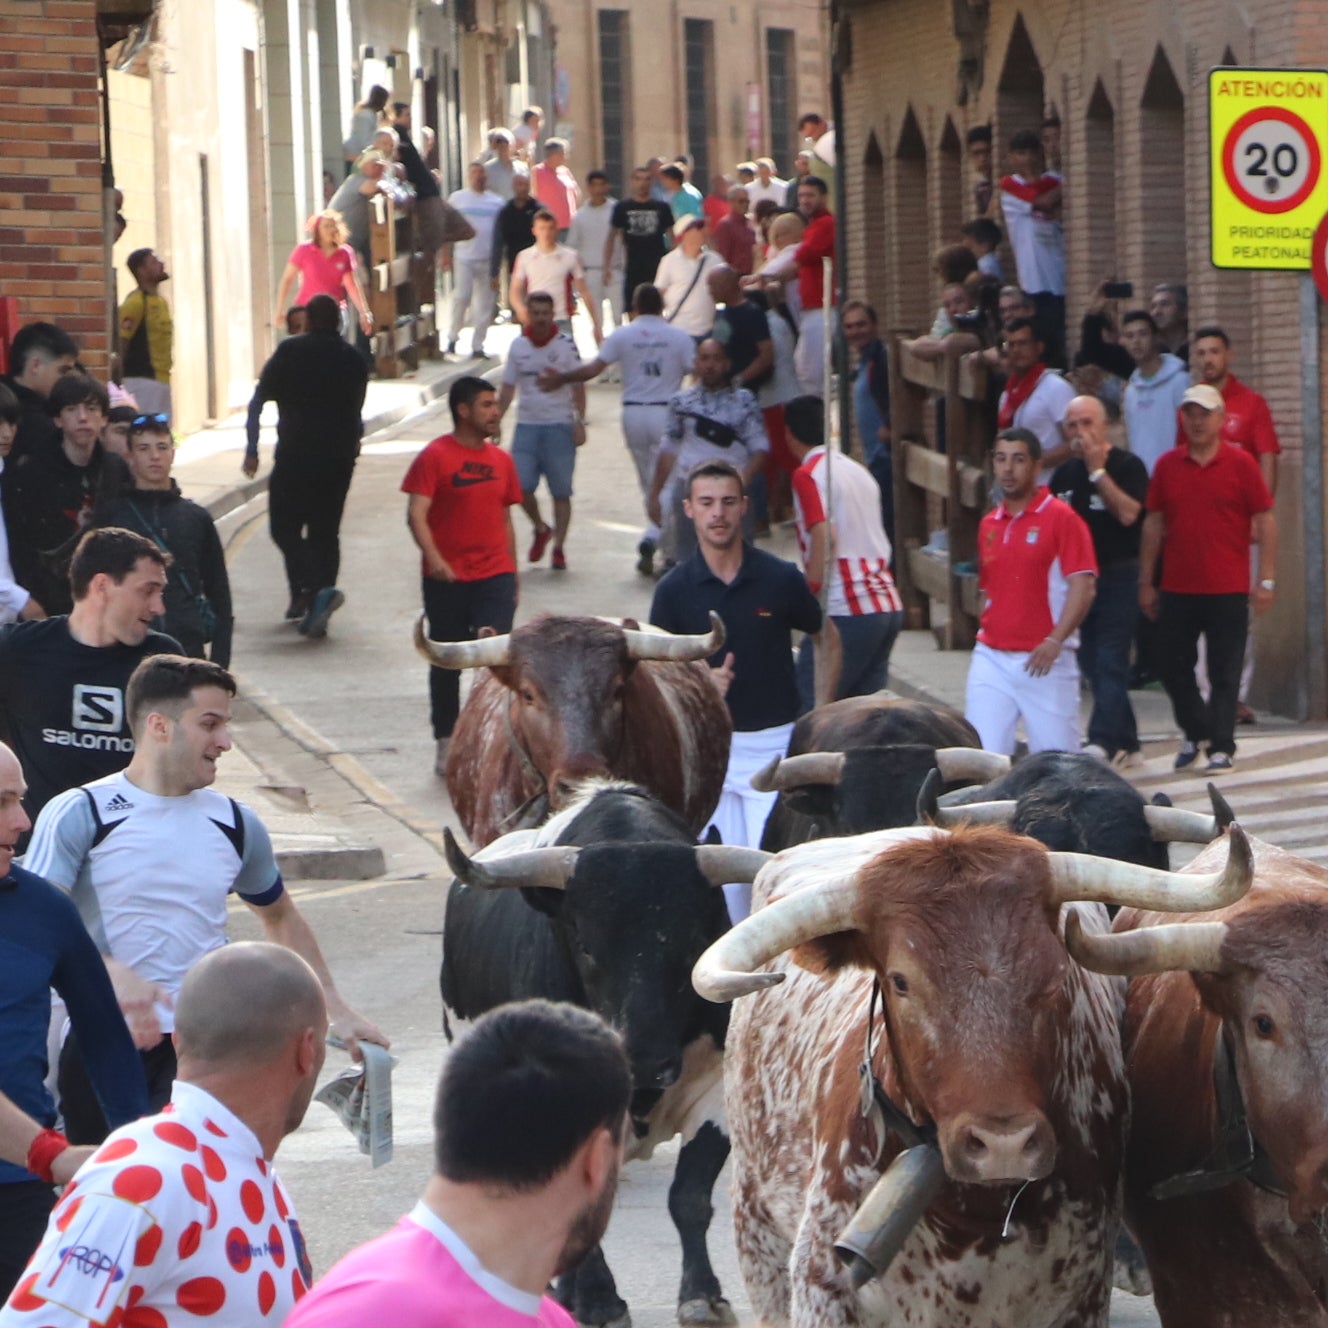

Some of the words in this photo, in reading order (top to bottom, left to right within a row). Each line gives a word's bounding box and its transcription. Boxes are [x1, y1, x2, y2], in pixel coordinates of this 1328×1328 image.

[1217, 77, 1322, 98] ATENCIÓN
[1245, 142, 1298, 177] 20
[1229, 225, 1313, 239] PRIORIDAD
[1232, 245, 1311, 260] PEATONAL
[105, 802, 135, 812] adidas
